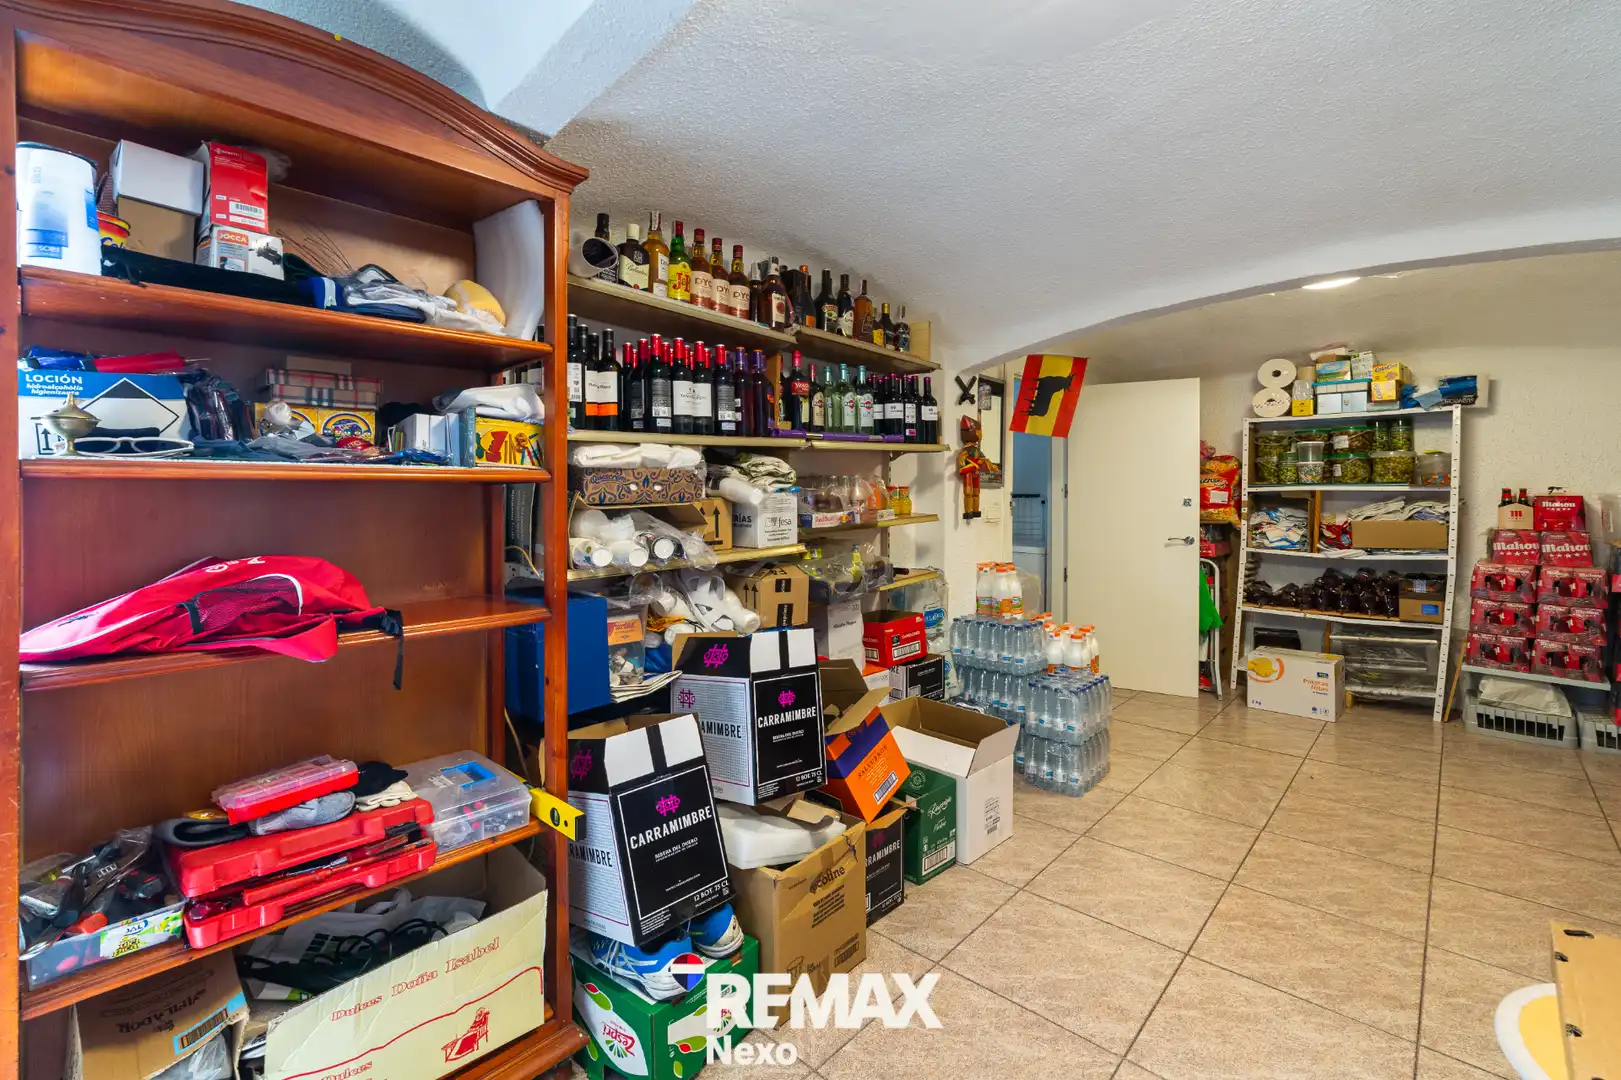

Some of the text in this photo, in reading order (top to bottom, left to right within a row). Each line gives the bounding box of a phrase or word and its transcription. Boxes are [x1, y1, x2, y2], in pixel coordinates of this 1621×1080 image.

[25, 373, 83, 385] LOCIÓN
[1493, 541, 1540, 551] Mahou
[1541, 543, 1591, 553] Mahou
[757, 706, 817, 728] CARRAMIMBRE
[701, 720, 742, 739] AMIMBRE
[630, 805, 712, 850] CARRAMIMBRE
[569, 843, 613, 868] RAMIMBRE
[865, 839, 900, 867] RAMIMBRE
[721, 880, 729, 888] CL
[331, 936, 501, 1022] Dulces Doña Isabel
[602, 1023, 635, 1057] Zespri
